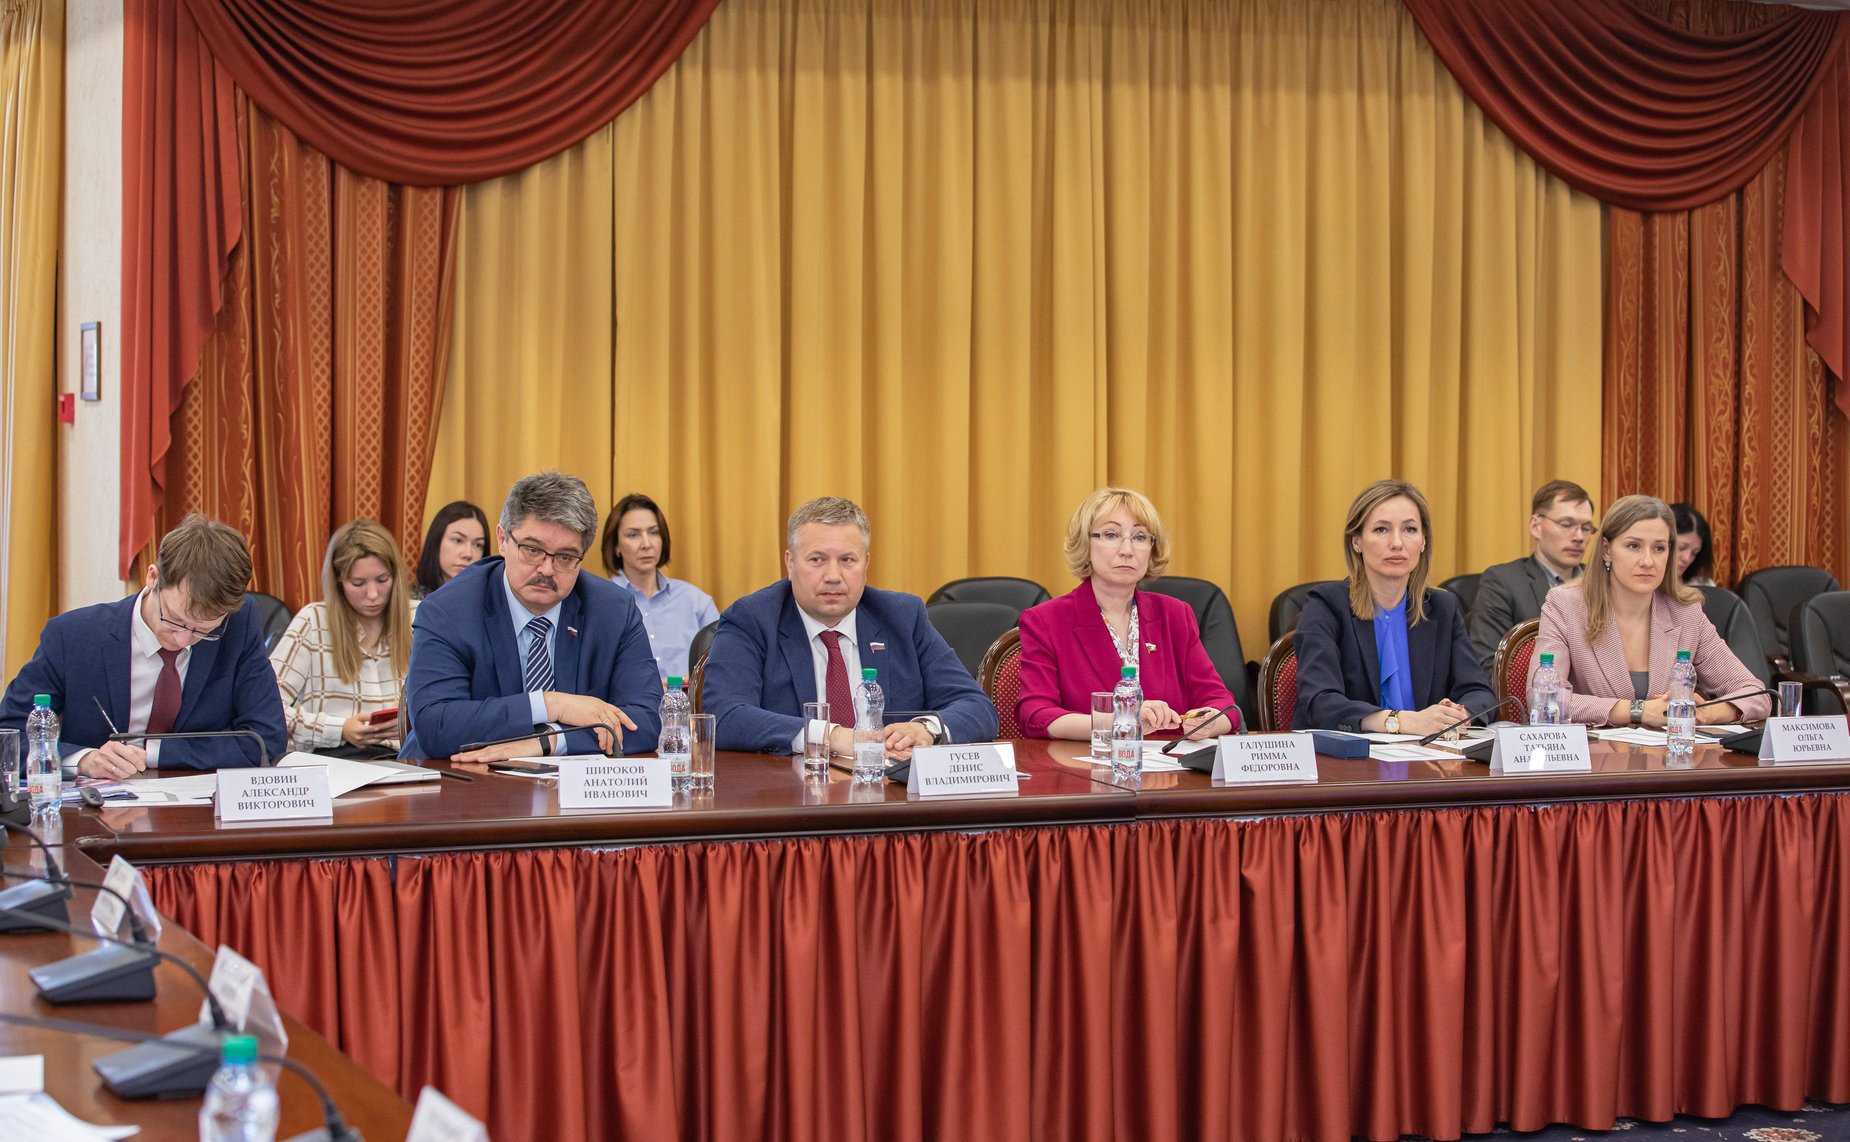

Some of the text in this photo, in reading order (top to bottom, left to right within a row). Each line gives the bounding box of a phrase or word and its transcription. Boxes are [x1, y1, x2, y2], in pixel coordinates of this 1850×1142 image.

[1782, 723, 1836, 732] МАКСИМОВА
[1519, 732, 1567, 741] САХАРОВА
[1797, 734, 1824, 742] ОЛЬГА
[1240, 740, 1296, 750] ГАЛУШИНА
[1793, 744, 1832, 752] ЮРЬЕВНА
[949, 752, 980, 762] ГУСЕВ
[1118, 750, 1135, 759] ВОДА
[1251, 752, 1288, 761] РИММА
[1513, 753, 1580, 763] АНАЛЬЕВНА
[586, 766, 645, 775] ШИРОКОВ
[949, 763, 984, 773] ДЕНИС
[1241, 763, 1300, 773] ФЕДОРОВНА
[251, 775, 297, 785] ВДОВИН
[583, 776, 648, 787] АНАТОЛИЙ
[925, 774, 1010, 786] ВЛАДИМИРОВИЧ
[241, 786, 310, 798] АЛЕКСАНДР
[584, 790, 648, 799] ИВАНОВИЧ
[237, 799, 315, 810] ВИКТОРОВИЧ
